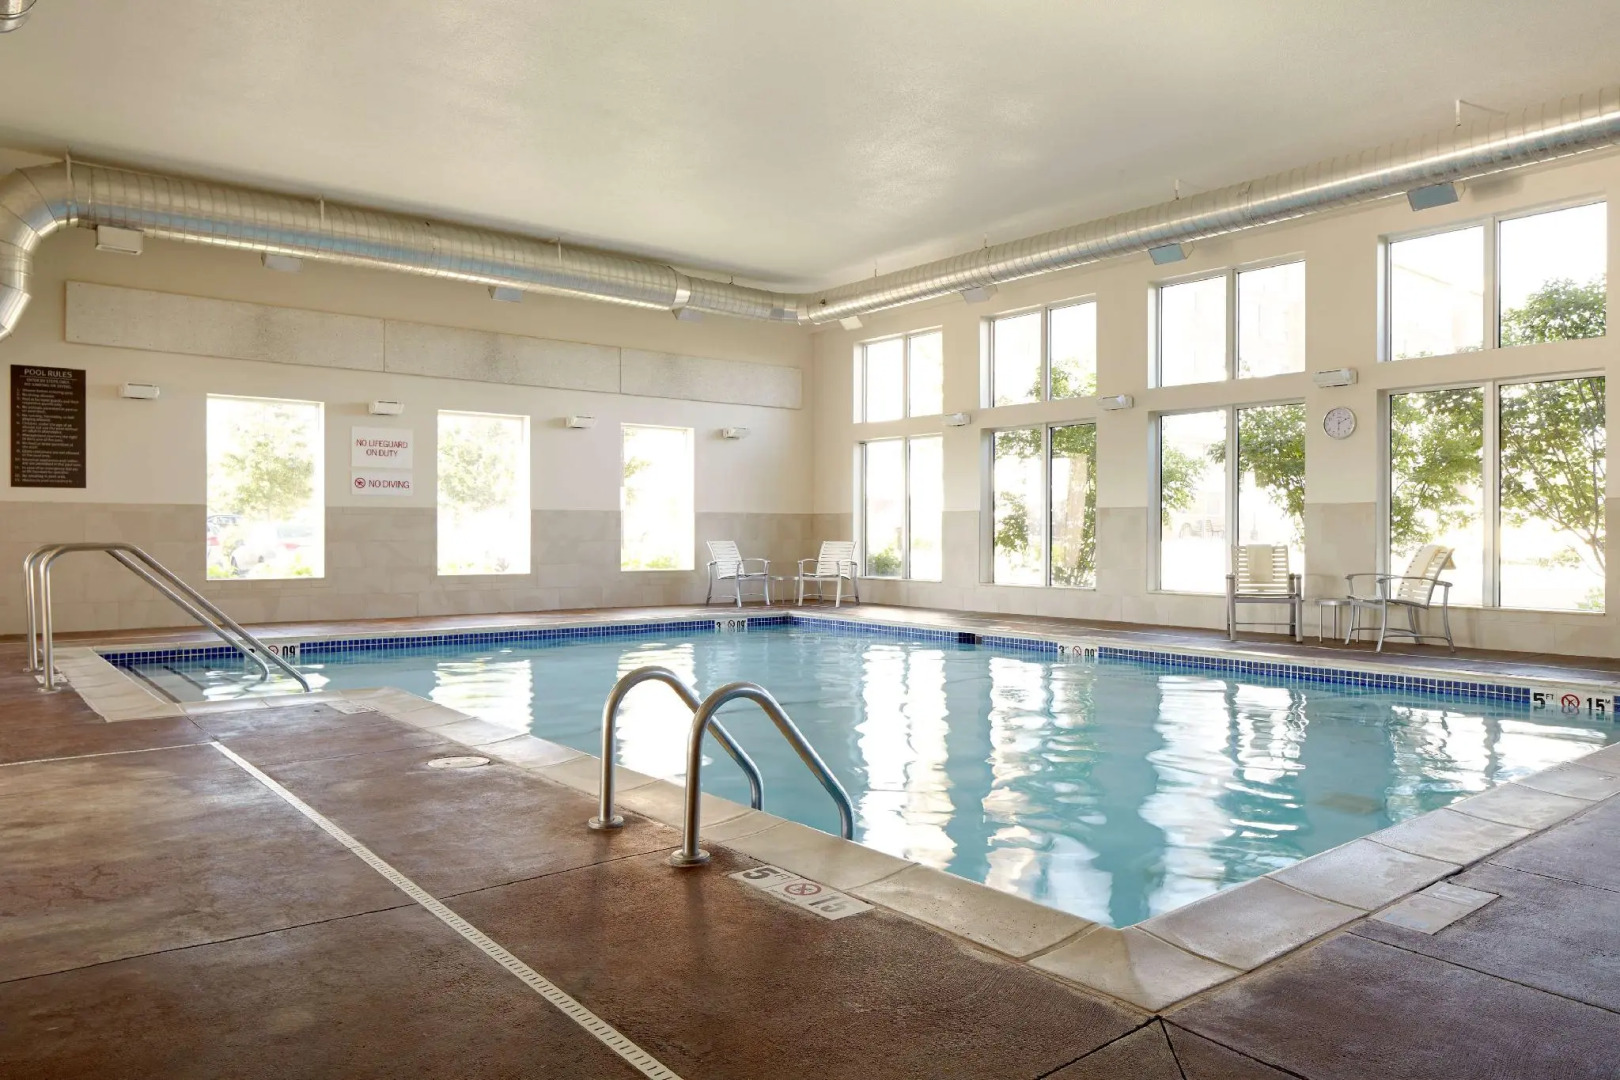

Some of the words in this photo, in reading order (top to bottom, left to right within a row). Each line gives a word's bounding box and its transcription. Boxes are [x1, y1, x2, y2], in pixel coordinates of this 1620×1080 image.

[24, 368, 46, 376] POOL
[47, 370, 73, 378] RULES
[369, 440, 408, 449] LIFEGUARD
[378, 449, 398, 457] DUTY
[368, 480, 381, 488] NO
[382, 480, 410, 489] DIVING
[742, 867, 780, 880] 5
